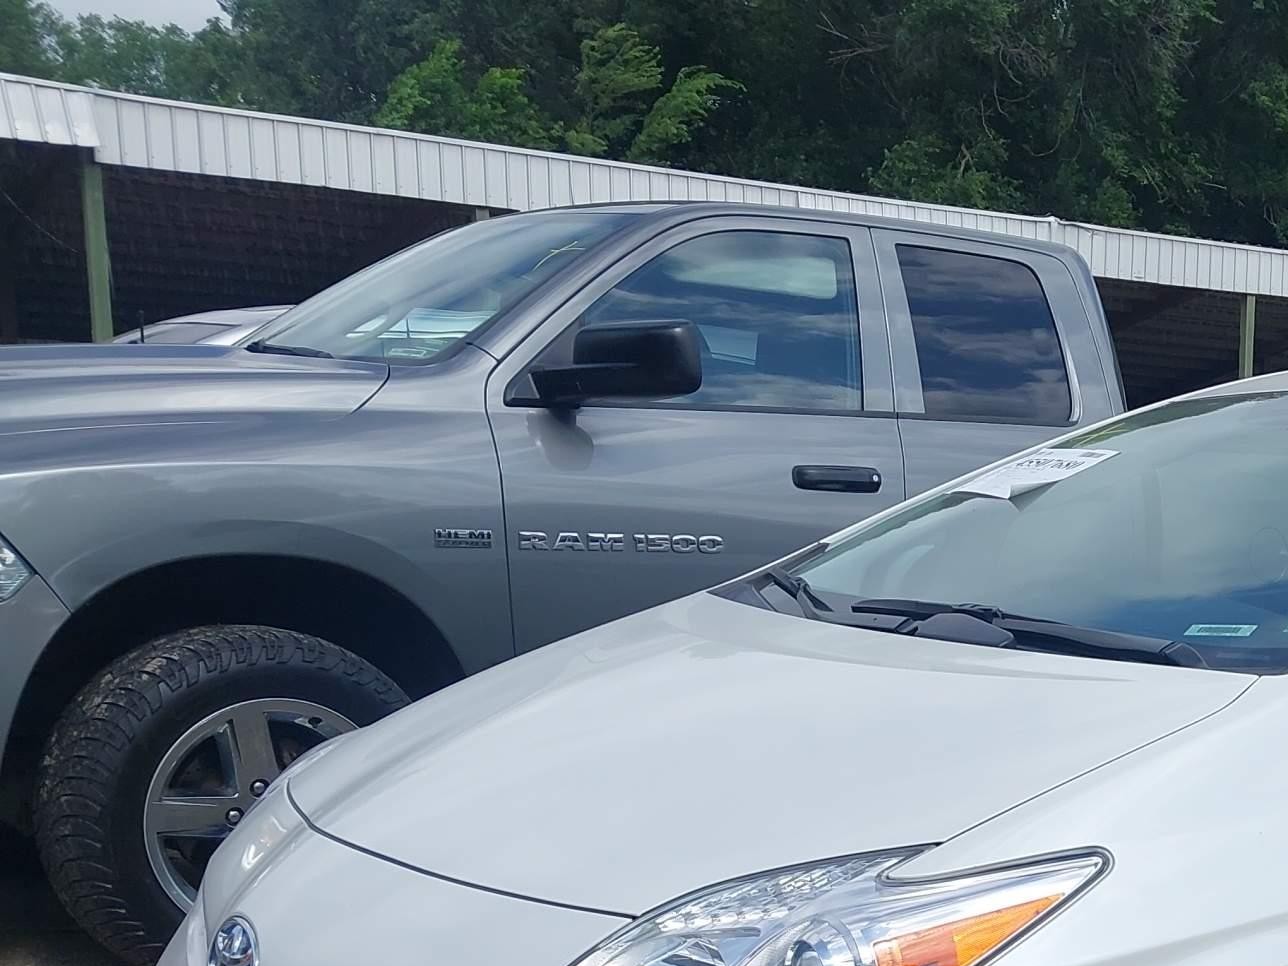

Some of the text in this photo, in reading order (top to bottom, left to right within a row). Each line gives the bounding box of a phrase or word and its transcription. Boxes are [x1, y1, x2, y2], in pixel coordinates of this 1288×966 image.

[434, 528, 493, 540] HEMI
[518, 531, 724, 554] RAM 1500
